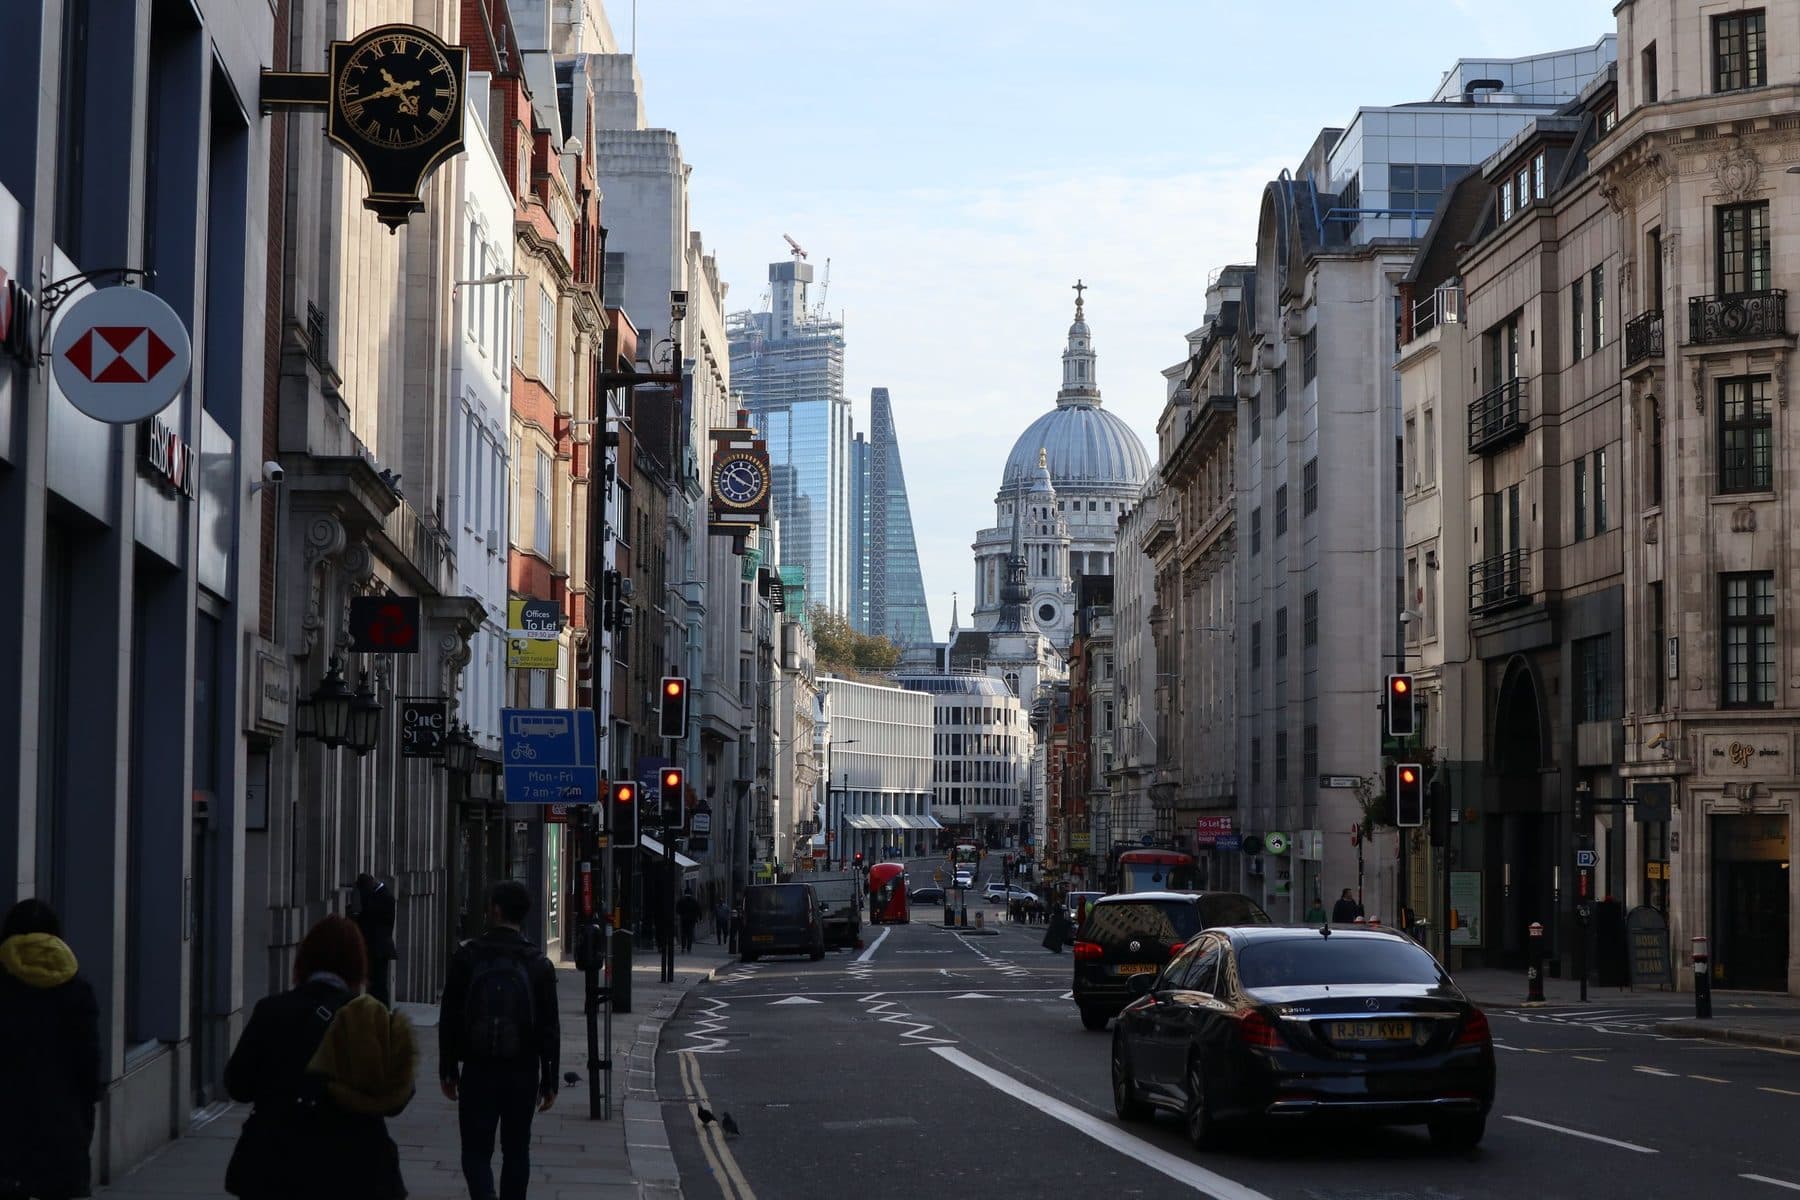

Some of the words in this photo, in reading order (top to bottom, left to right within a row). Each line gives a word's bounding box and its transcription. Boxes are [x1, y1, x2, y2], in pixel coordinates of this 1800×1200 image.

[391, 40, 406, 54] XII
[149, 415, 173, 480] HSBC
[184, 443, 196, 500] UK
[525, 609, 550, 618] Offices
[525, 619, 537, 630] To
[541, 620, 556, 630] Let
[405, 709, 442, 728] One
[1729, 741, 1755, 768] Eye
